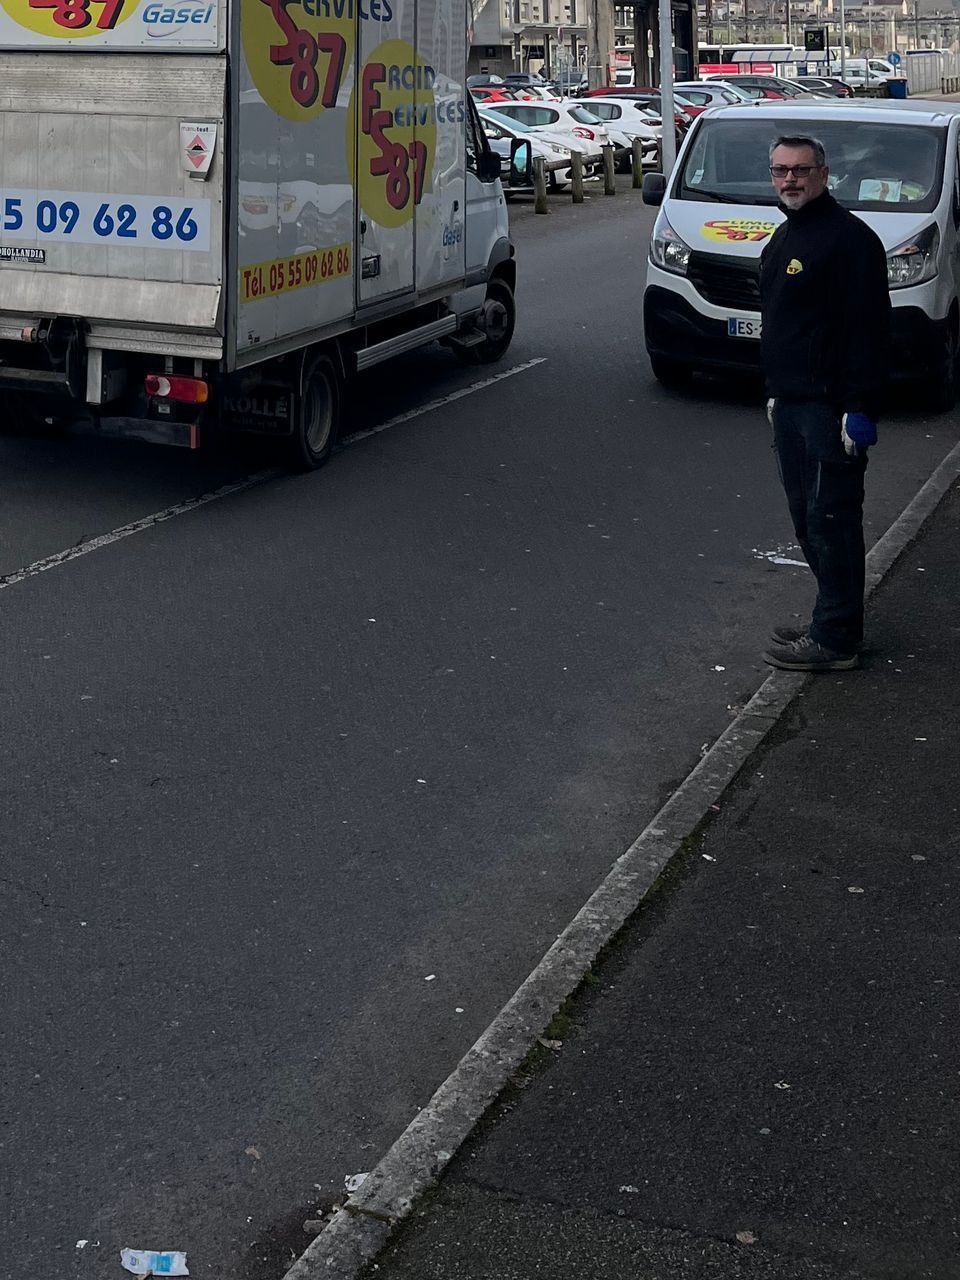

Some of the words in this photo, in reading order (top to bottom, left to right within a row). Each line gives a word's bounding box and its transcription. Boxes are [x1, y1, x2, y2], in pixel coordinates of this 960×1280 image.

[142, 3, 214, 24] Gasel
[290, 29, 346, 108] 87
[362, 63, 436, 135] FROID
[386, 141, 427, 209] 87
[36, 200, 80, 233] 09
[93, 203, 137, 238] 62
[151, 206, 198, 241] 86
[704, 220, 780, 229] CLIMA
[727, 231, 771, 241] 87
[243, 267, 266, 298] Tél.
[270, 264, 284, 292] 05
[288, 259, 302, 288] 55
[305, 254, 318, 282] 09
[321, 251, 334, 278] 62
[337, 248, 349, 274] 86
[738, 321, 762, 336] ES-
